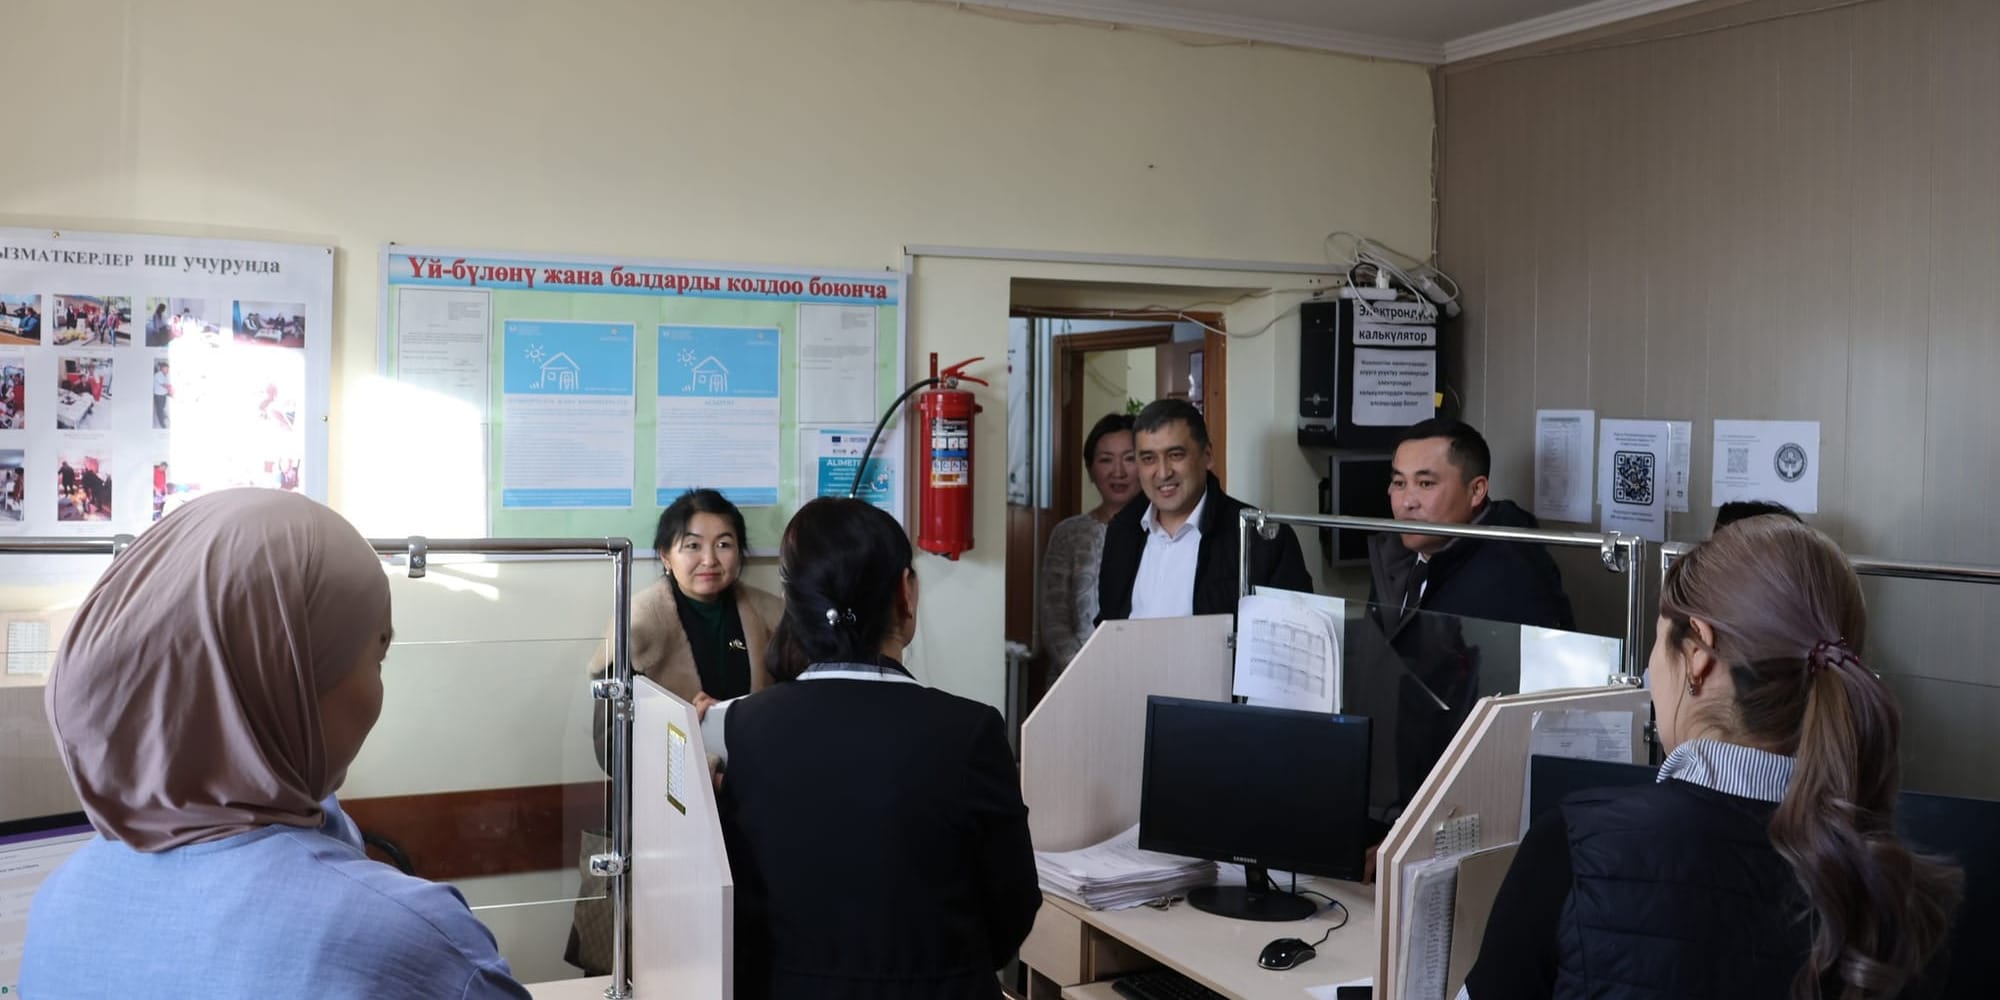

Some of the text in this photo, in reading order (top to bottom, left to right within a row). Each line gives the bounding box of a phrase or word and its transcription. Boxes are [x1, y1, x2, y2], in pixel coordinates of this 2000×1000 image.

[144, 253, 177, 268] иш
[183, 255, 281, 276] учурунда
[407, 255, 888, 300] Үй-бүлөнү жана балдарды колдоо боюнча
